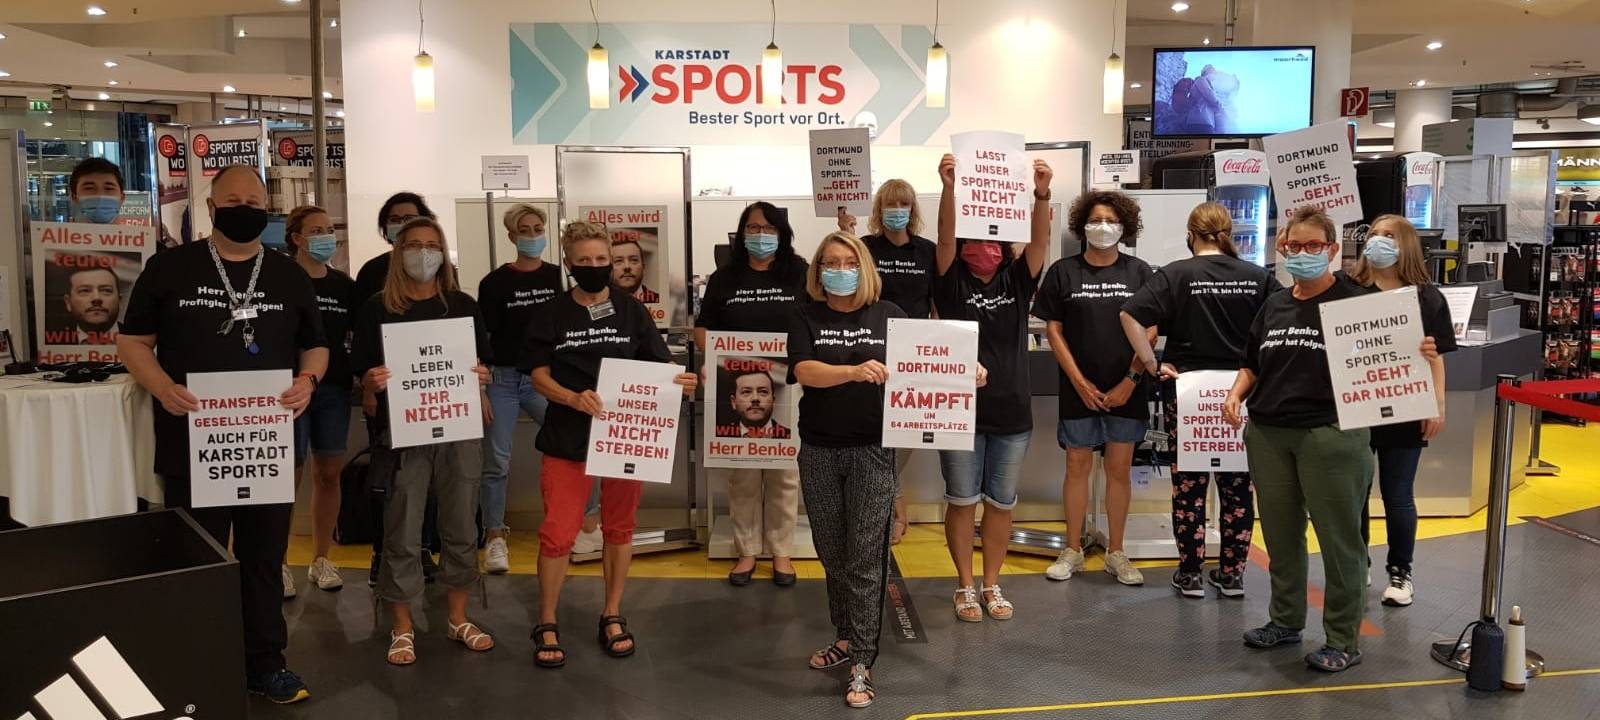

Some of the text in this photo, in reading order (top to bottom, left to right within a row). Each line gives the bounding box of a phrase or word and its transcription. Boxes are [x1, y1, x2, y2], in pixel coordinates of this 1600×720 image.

[655, 50, 730, 60] KARSTADT
[689, 111, 845, 127] Bester Sport vor Ort.
[209, 141, 257, 155] SPORT IST
[816, 145, 863, 155] DORTMUND
[1133, 141, 1194, 149] NEUE RUNNING-
[975, 150, 1007, 162] LASST
[1277, 143, 1339, 164] DORTMUND
[203, 157, 217, 168] WO
[828, 158, 852, 166] OHNE
[1295, 160, 1327, 174] OHNE
[820, 169, 861, 178] SPORTS...
[975, 164, 1009, 176] UNSER
[823, 180, 861, 190] ...GEHT
[961, 176, 1026, 192] SPORTHAUS
[1286, 173, 1341, 190] SPORTS...
[816, 191, 869, 202] GAR NICHT!
[971, 189, 1017, 205] NICHT
[1292, 182, 1341, 204] ...GEHT
[588, 209, 660, 224] Alles wird
[961, 204, 1026, 221] STERBEN!
[41, 227, 145, 247] Alles wird
[53, 252, 120, 268] teurer
[197, 286, 225, 297] Herr
[514, 287, 555, 298] Herr Benko
[736, 287, 783, 296] Herr Benko
[1101, 282, 1127, 290] Benko
[179, 298, 228, 309] Profitgier
[566, 326, 618, 338] Herr Benko
[820, 327, 872, 337] Herr Benko
[1267, 326, 1319, 338] Herr Benko
[1335, 314, 1409, 337] DORTMUND
[45, 328, 81, 343] wir
[603, 335, 631, 343] Folgen!
[857, 336, 885, 346] Folgen!
[1285, 338, 1299, 346] hat
[1355, 334, 1393, 350] OHNE
[419, 345, 443, 356] WIR
[714, 336, 786, 352] Alles wir
[915, 345, 949, 357] TEAM
[37, 350, 82, 363] Herr
[1345, 351, 1411, 369] SPORTS...
[411, 360, 453, 374] LEBEN
[723, 358, 776, 371] teurer
[897, 362, 966, 375] DORTMUND
[1351, 364, 1411, 386] ...GEHT
[402, 374, 465, 391] SPORT(S)!
[621, 383, 659, 396] LASST
[419, 390, 450, 405] IHR
[890, 387, 973, 410] KÄMPFT
[1342, 380, 1428, 404] GAR NICHT!
[200, 396, 282, 410] TRANSFER-
[617, 398, 658, 412] UNSER
[1198, 402, 1225, 412] UNSE
[405, 402, 469, 423] NICHT!
[599, 410, 675, 429] SPORTHAUS
[923, 412, 936, 420] UM
[194, 414, 289, 428] GESELLSCHAFT
[903, 420, 968, 431] ARBEITSPLÄTZE
[207, 428, 278, 444] AUCH FÜR
[608, 424, 662, 442] NICHT
[716, 424, 791, 439] wir auch,
[1193, 427, 1239, 439] NICHT
[198, 446, 288, 463] KARSTADT
[595, 440, 669, 460] STERBEN!
[709, 441, 797, 457] Herr Benko
[208, 463, 279, 480] SPORTS
